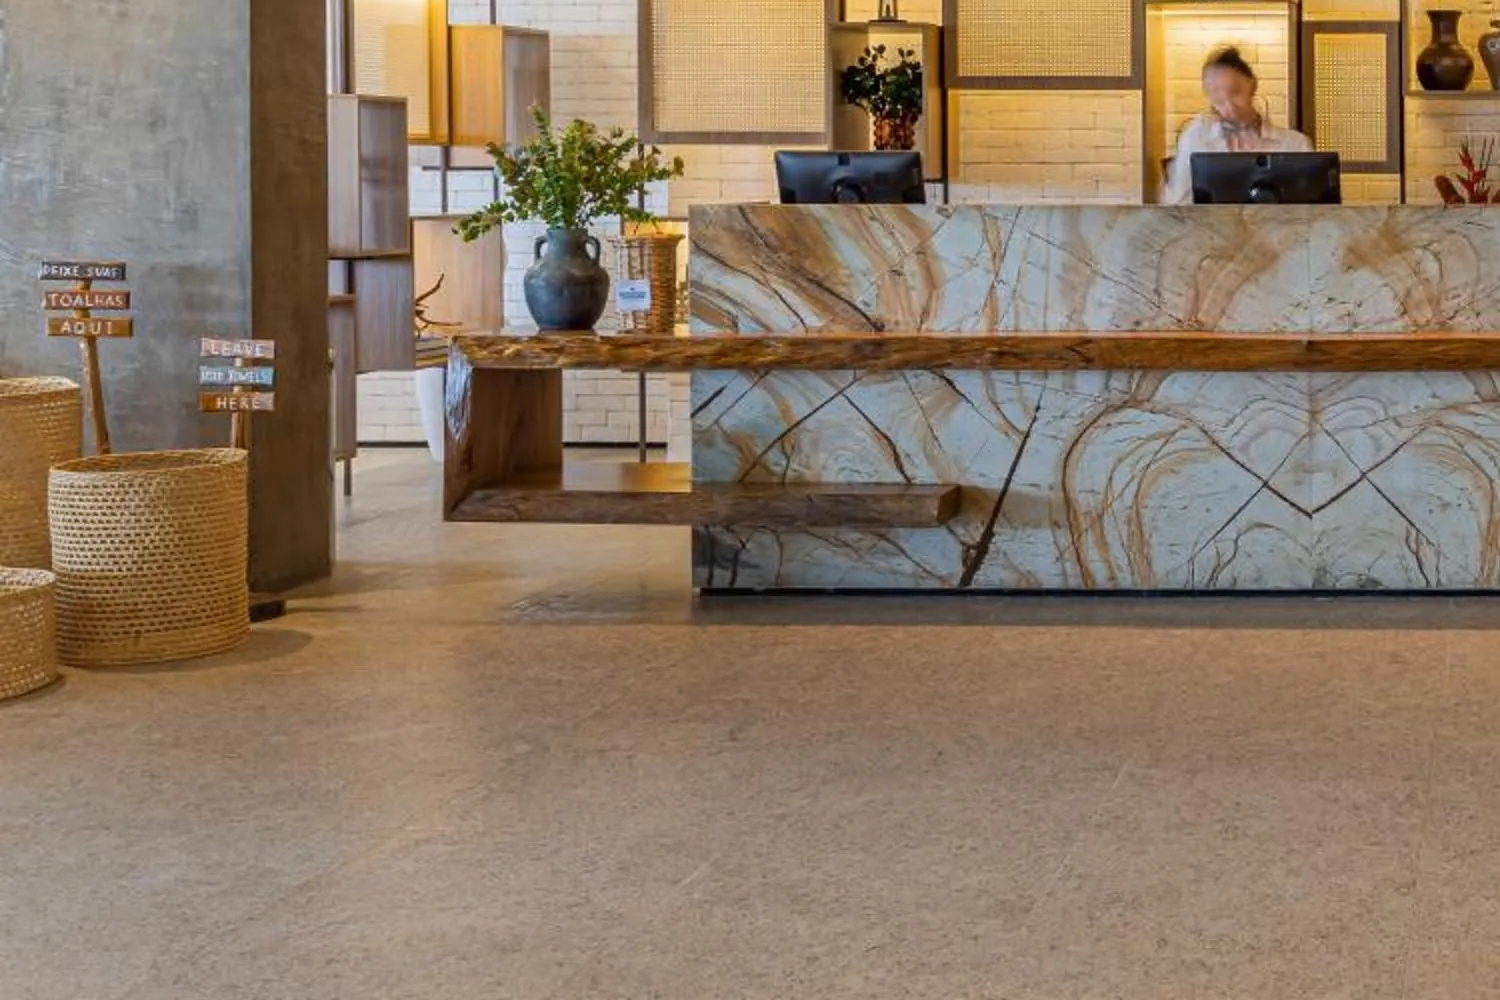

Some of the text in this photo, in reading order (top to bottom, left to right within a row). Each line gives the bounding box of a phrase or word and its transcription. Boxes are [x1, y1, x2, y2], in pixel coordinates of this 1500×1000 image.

[47, 292, 124, 308] TOALHAS
[210, 341, 266, 357] LEAVE
[215, 395, 263, 411] HERE
